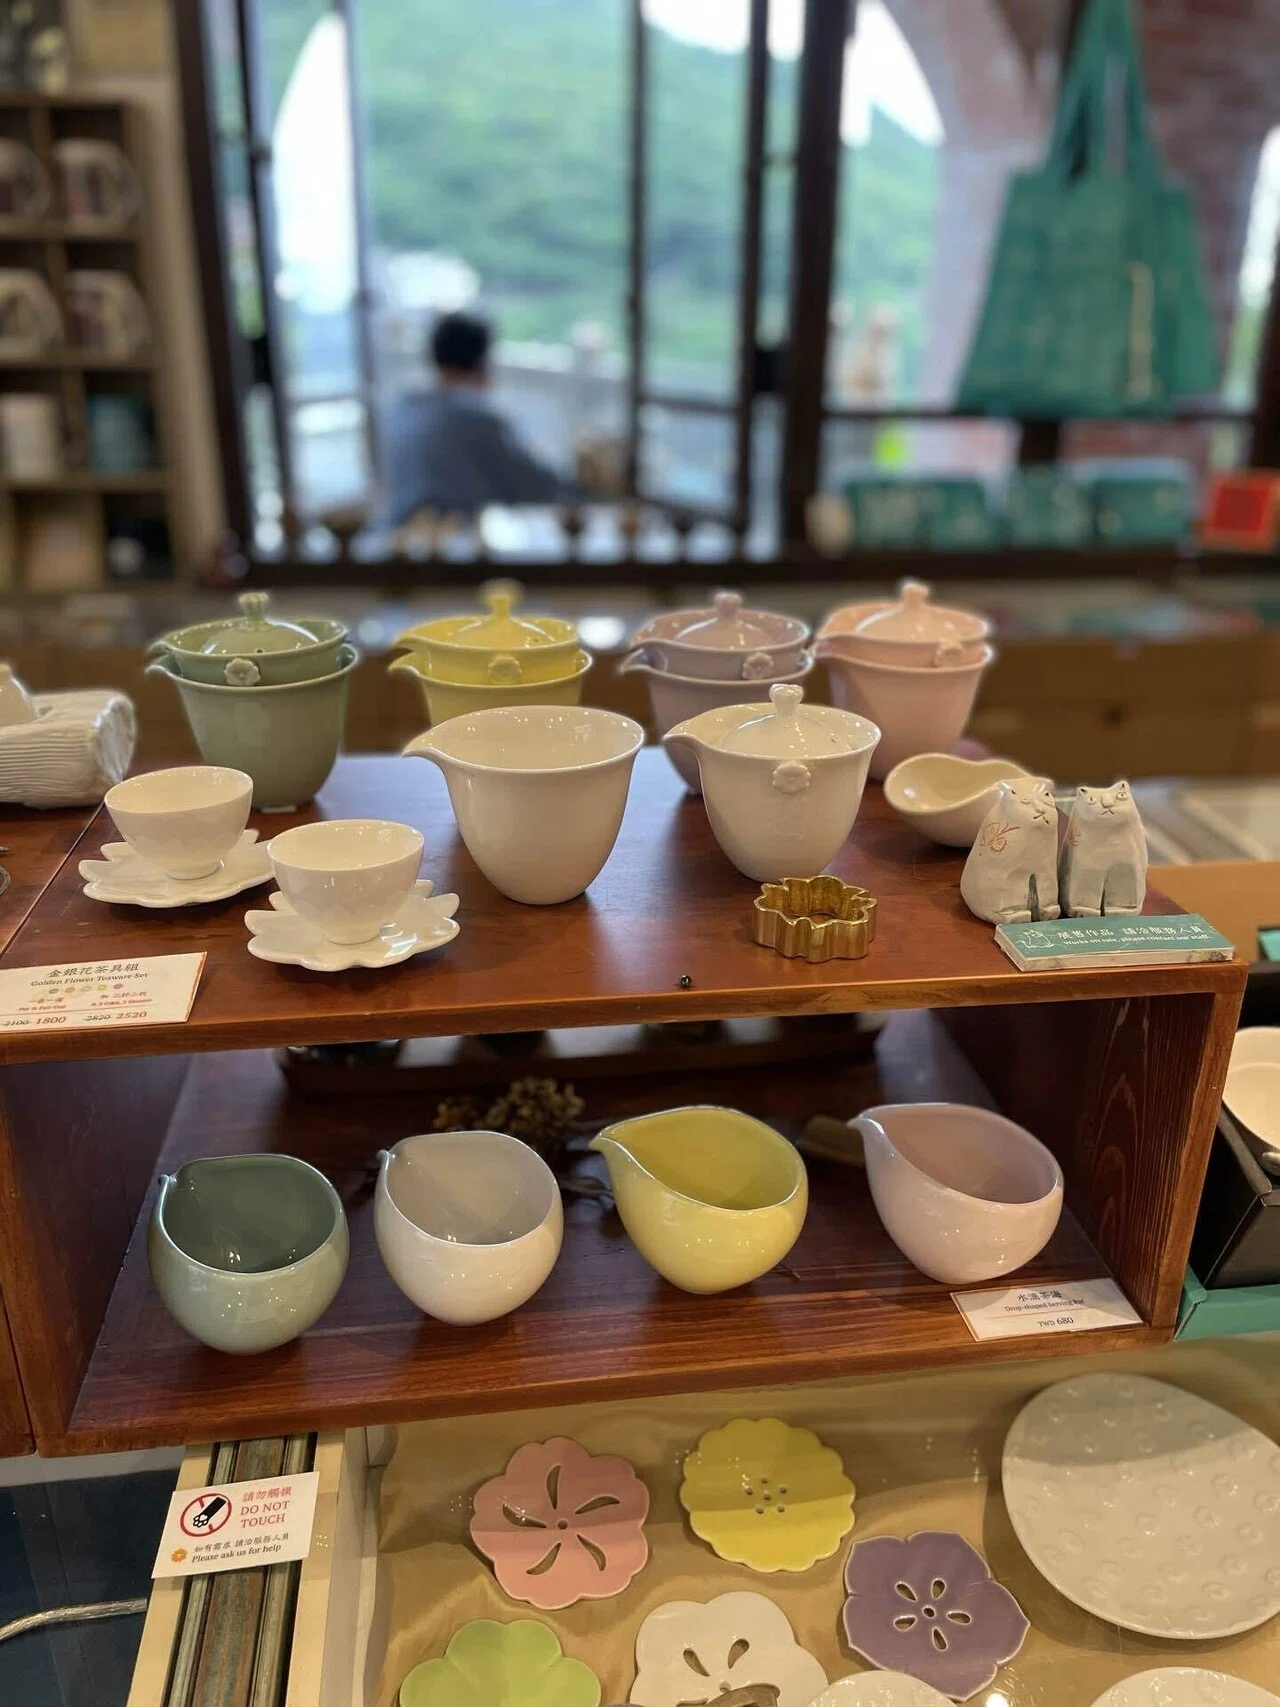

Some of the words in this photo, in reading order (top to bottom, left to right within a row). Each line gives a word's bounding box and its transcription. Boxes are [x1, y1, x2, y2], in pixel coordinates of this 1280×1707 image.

[47, 963, 139, 978] 金銀花茶具組
[30, 979, 62, 987] Golden
[64, 976, 94, 985] Flower
[97, 973, 131, 982] Teaware
[36, 1016, 67, 1025] 1800
[115, 1011, 147, 1019] 2520
[1037, 1319, 1056, 1327] TWD
[1056, 1316, 1074, 1325] 680
[243, 1486, 292, 1502] 請勿觸摸
[240, 1504, 260, 1516] DO
[262, 1500, 291, 1513] NOT
[241, 1513, 286, 1528] TOUCH
[194, 1541, 231, 1552] 如有需求
[234, 1532, 290, 1548] 請洽服務人員
[192, 1554, 220, 1563] Please
[220, 1550, 235, 1559] ask
[247, 1547, 261, 1556] for
[262, 1544, 282, 1553] help
